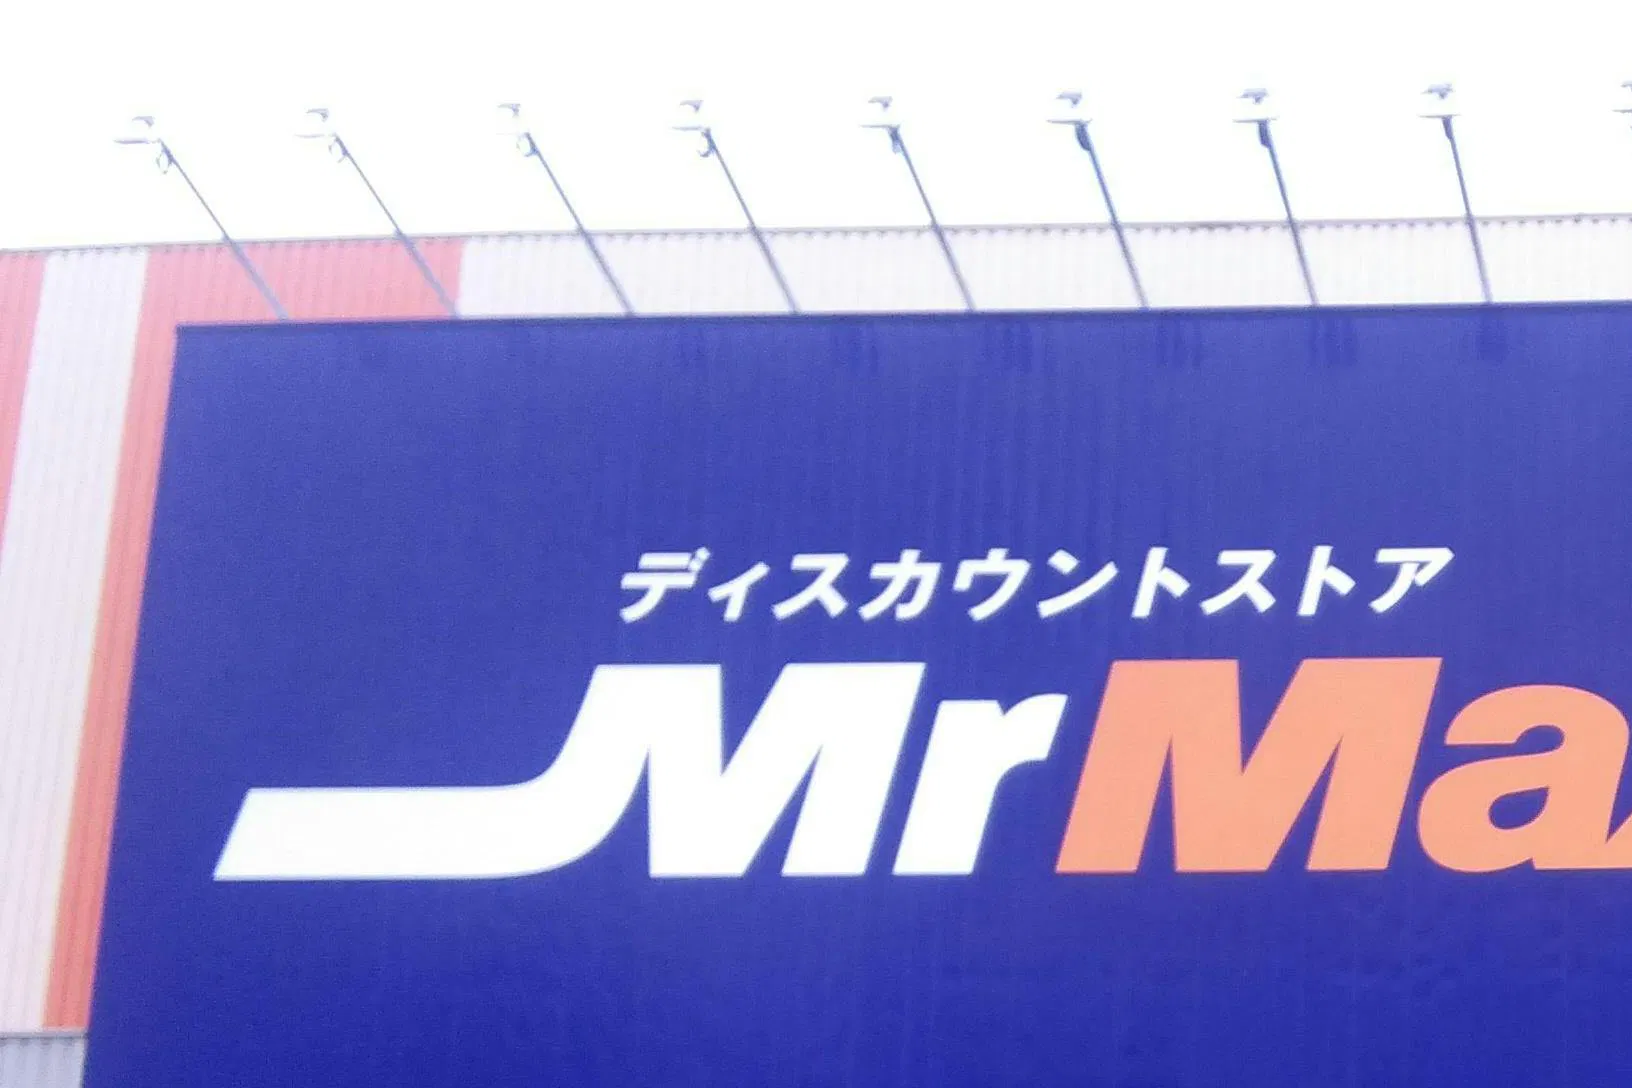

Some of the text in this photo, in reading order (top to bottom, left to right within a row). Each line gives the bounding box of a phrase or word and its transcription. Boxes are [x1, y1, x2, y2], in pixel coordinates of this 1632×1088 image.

[620, 544, 1454, 623] ディスカウントストア
